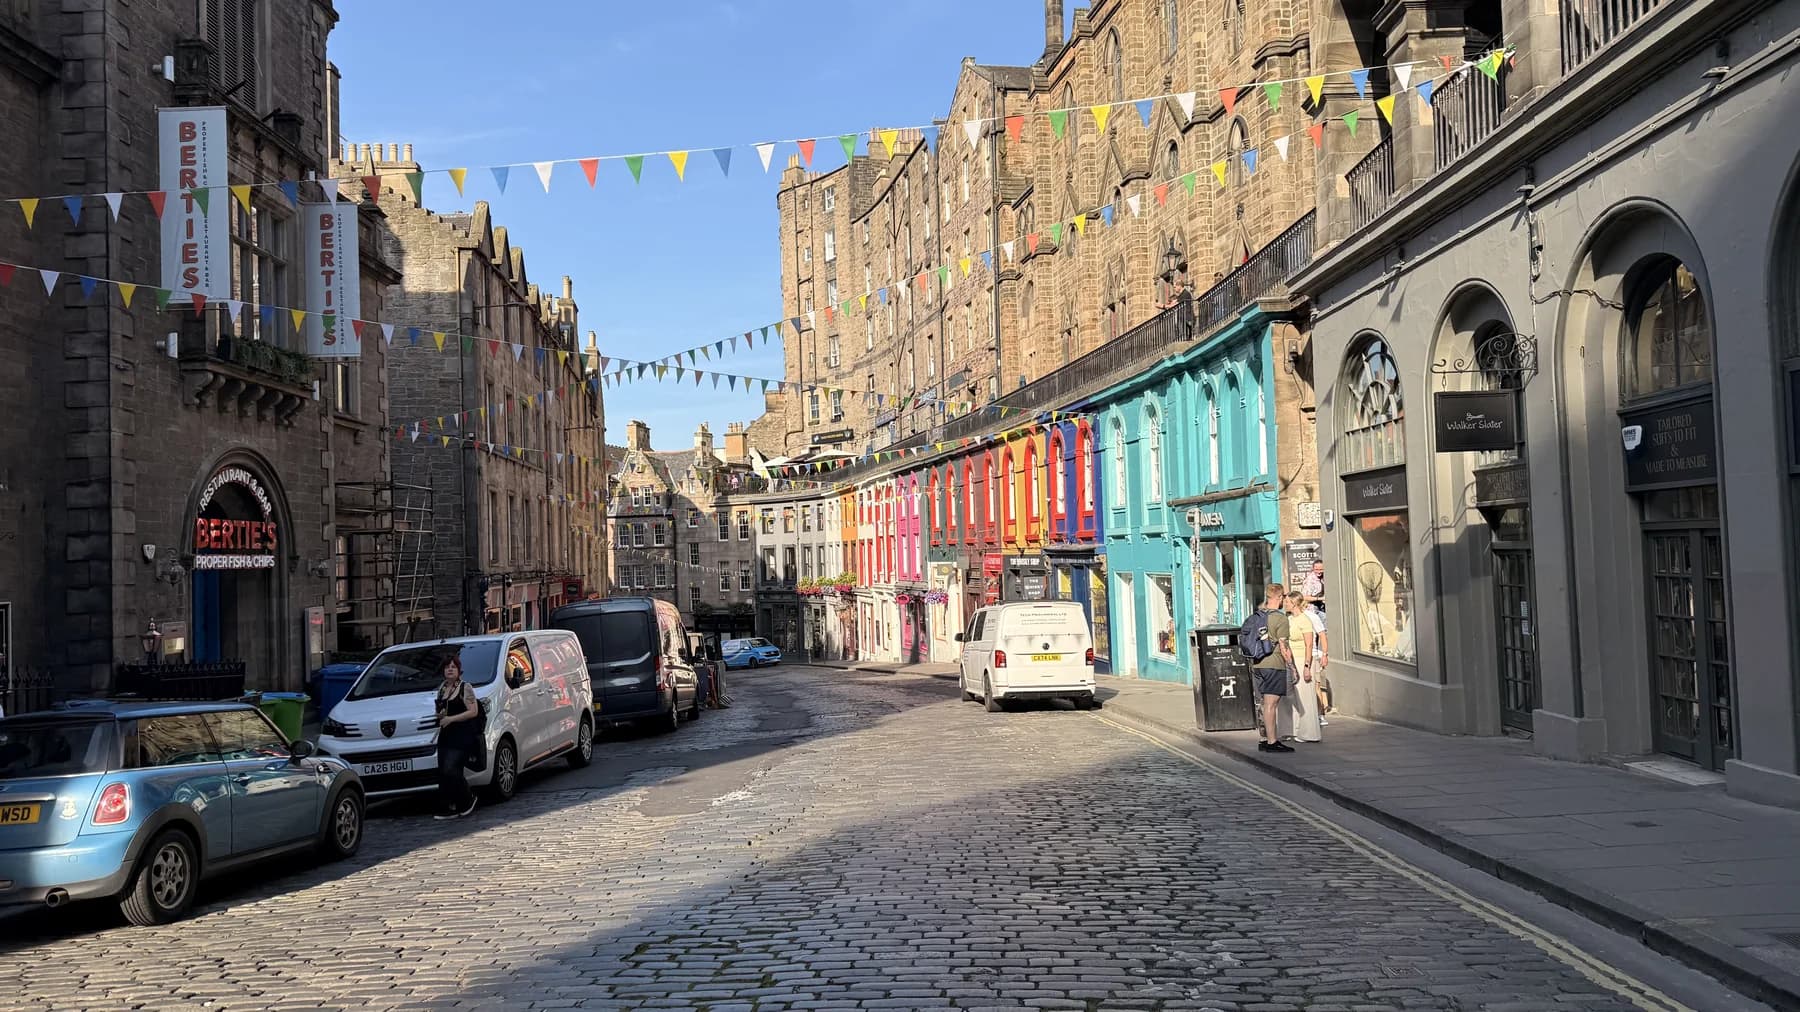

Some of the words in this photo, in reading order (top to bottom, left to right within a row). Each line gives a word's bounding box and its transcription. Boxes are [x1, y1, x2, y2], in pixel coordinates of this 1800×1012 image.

[179, 121, 199, 289] BERTIES
[1446, 420, 1478, 430] Walker
[1478, 420, 1503, 429] Slater
[1656, 413, 1692, 431] TAILORED
[1652, 431, 1673, 446] SUITS
[1674, 428, 1684, 443] TO
[1685, 426, 1696, 441] FIT
[1670, 443, 1680, 457] &
[1646, 460, 1665, 473] MADE
[1666, 459, 1675, 471] TO
[1675, 454, 1707, 471] MEASURE
[199, 469, 252, 512] RESTAURANT
[249, 479, 259, 492] &
[256, 487, 272, 516] BAR
[1362, 485, 1379, 498] Walker
[1379, 483, 1393, 496] Slater
[196, 518, 277, 551] BERTIE'S
[195, 555, 228, 569] PROPER
[228, 555, 246, 569] FISH
[247, 555, 252, 567] &
[253, 555, 276, 568] CHIPS
[364, 763, 388, 774] CA26
[390, 761, 408, 772] HGU
[0, 807, 31, 823] WSD
